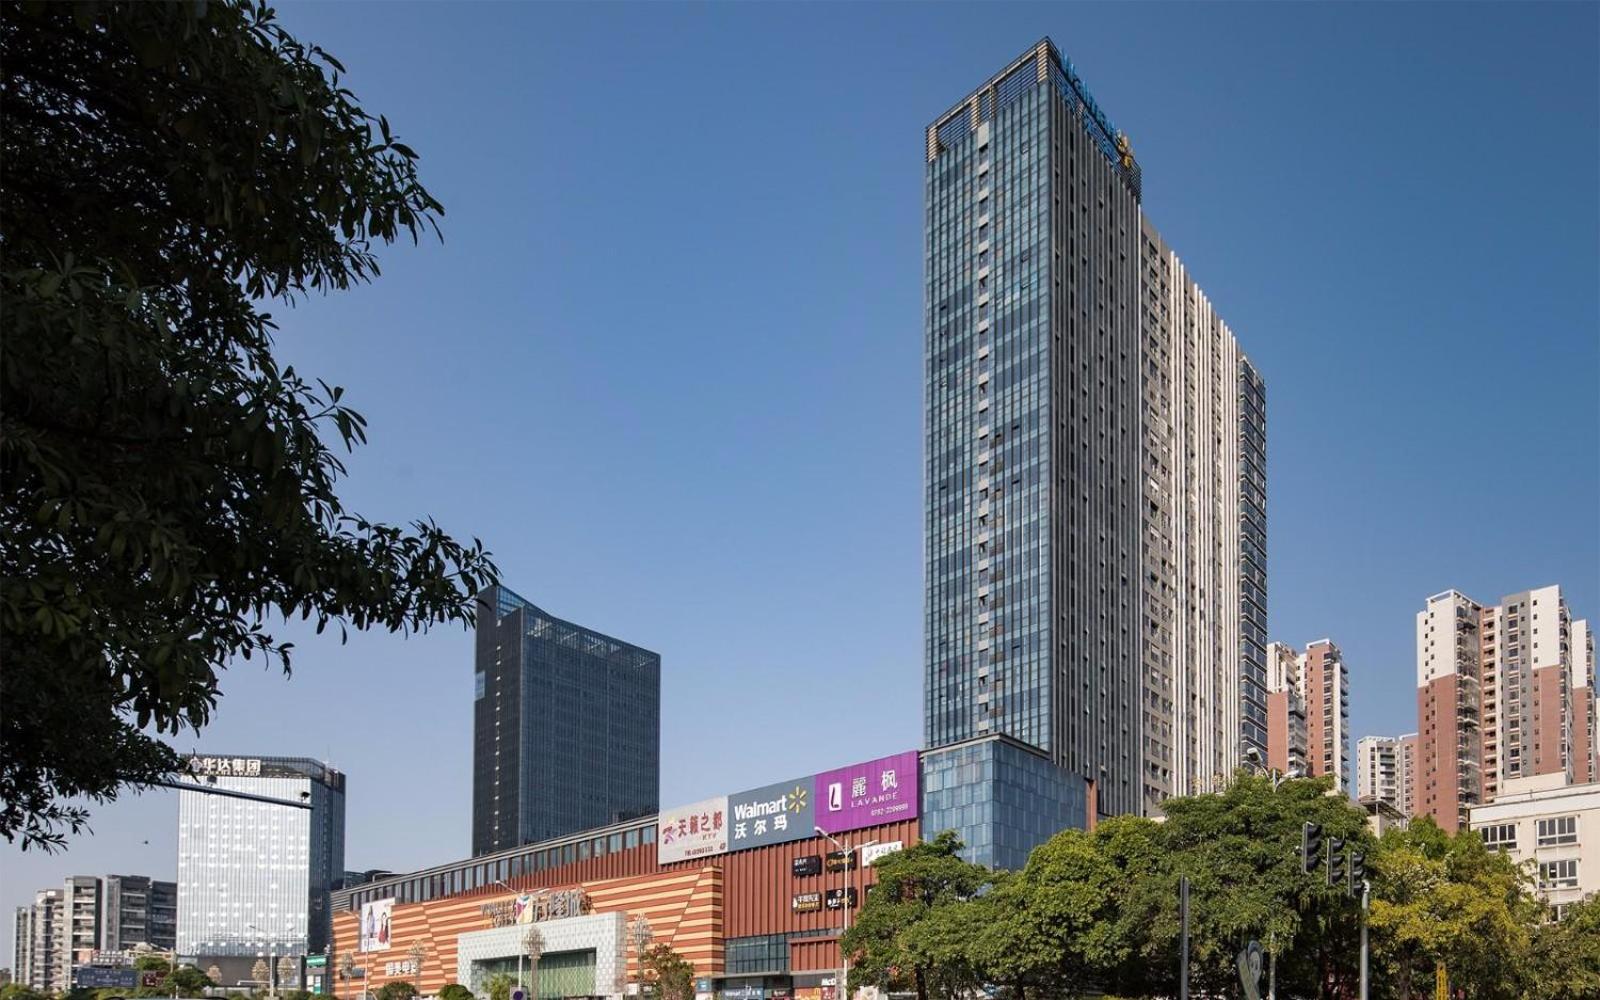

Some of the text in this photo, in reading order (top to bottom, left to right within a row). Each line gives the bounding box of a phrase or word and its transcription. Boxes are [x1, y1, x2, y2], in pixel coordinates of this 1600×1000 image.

[203, 758, 260, 773] 华达集团
[734, 794, 787, 821] Walmart
[851, 791, 898, 808] LAVANDE
[734, 813, 787, 840] 沃尔玛
